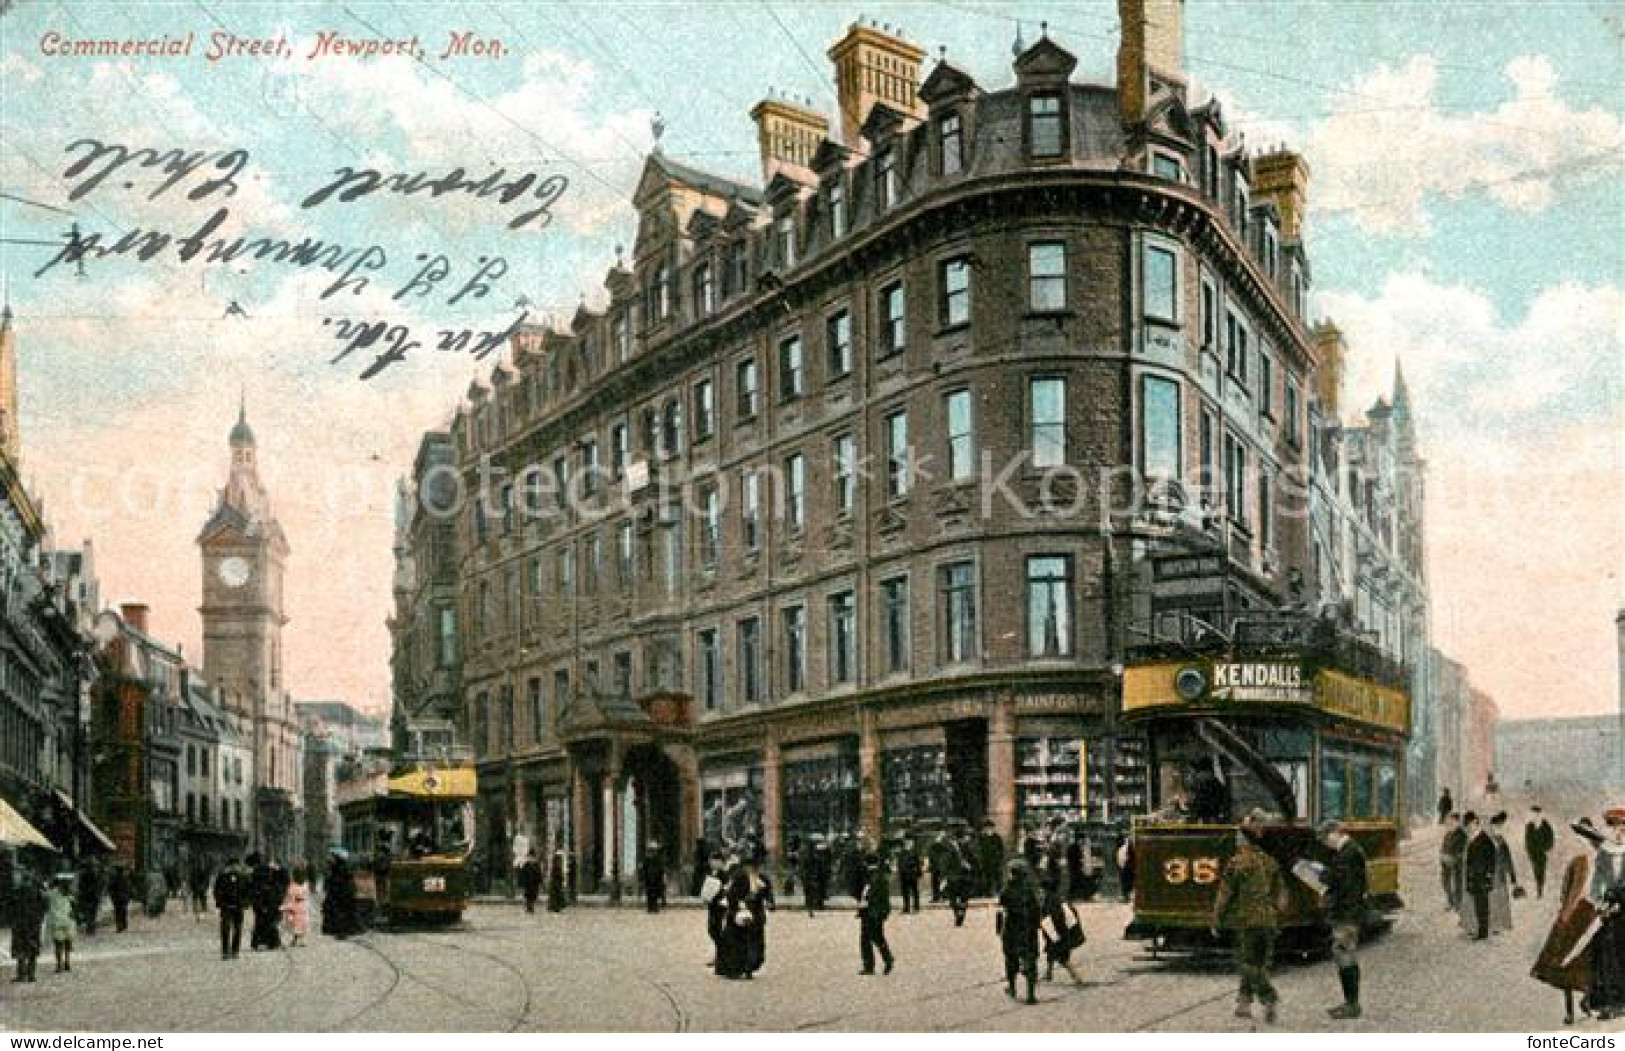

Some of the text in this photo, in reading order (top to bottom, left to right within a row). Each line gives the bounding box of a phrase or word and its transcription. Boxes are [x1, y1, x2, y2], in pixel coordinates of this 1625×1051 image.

[40, 31, 509, 61] Commercial Street, Newport, Mon.
[1213, 663, 1300, 687] KENDALLS
